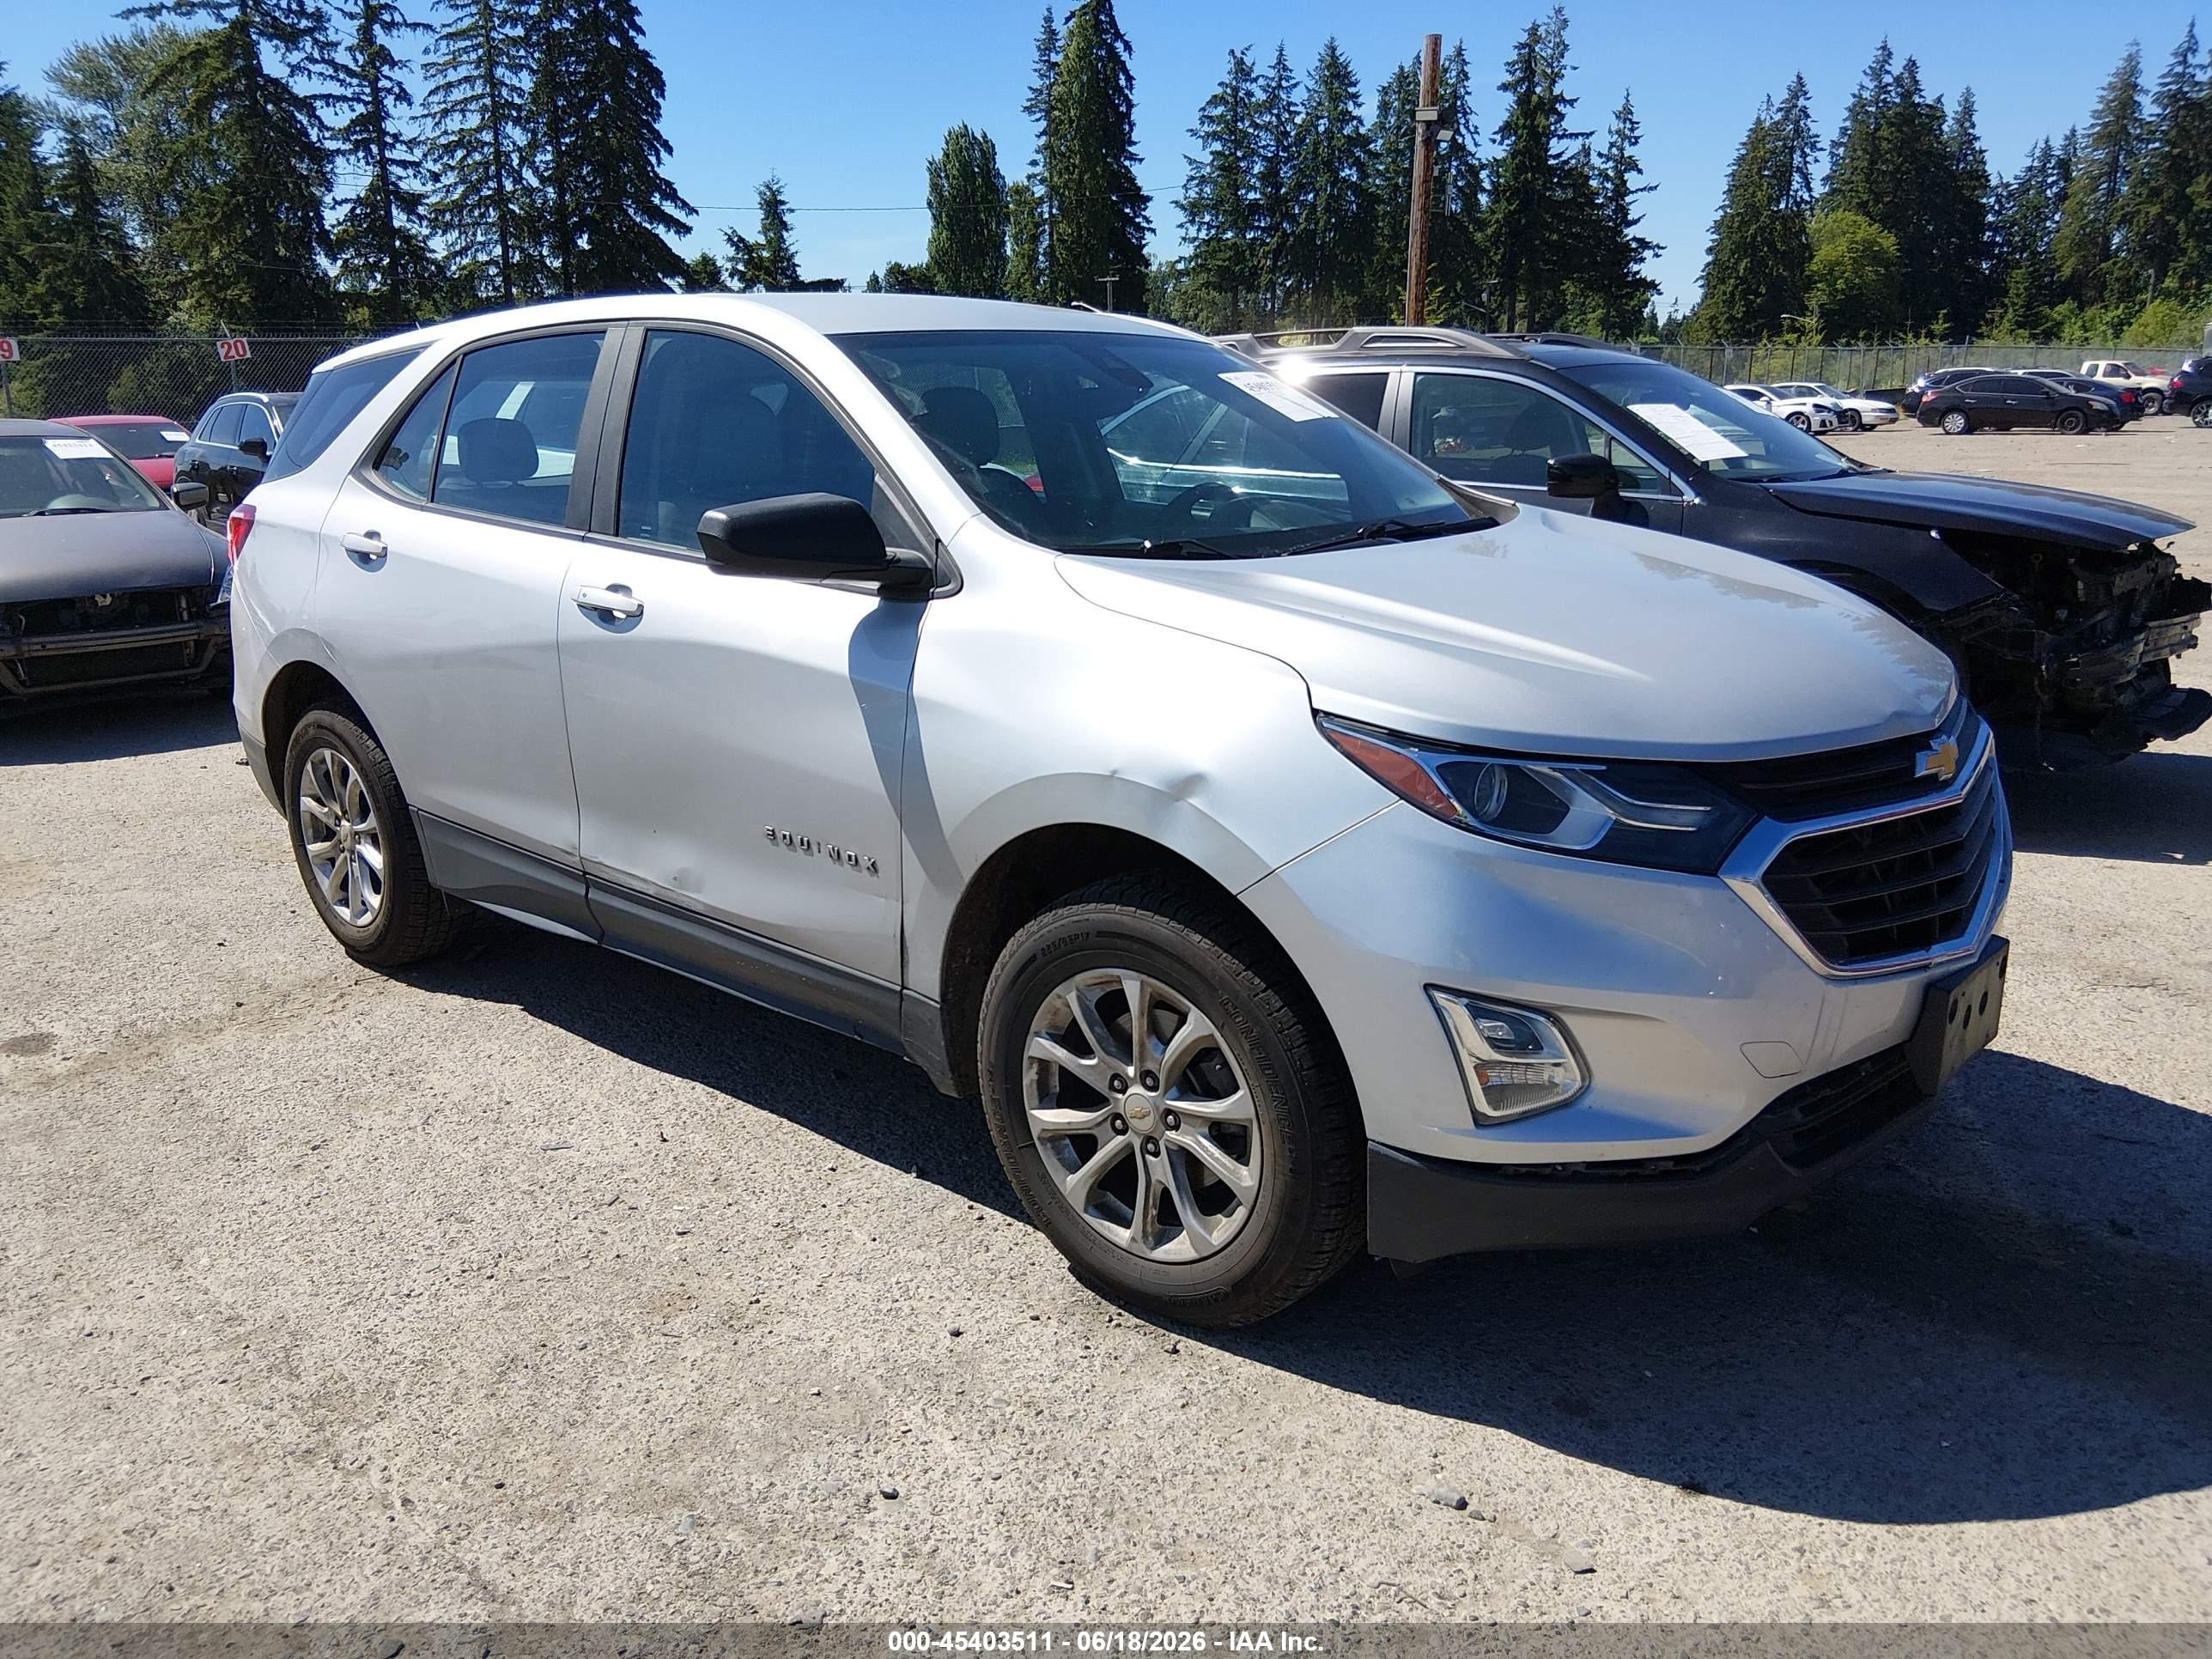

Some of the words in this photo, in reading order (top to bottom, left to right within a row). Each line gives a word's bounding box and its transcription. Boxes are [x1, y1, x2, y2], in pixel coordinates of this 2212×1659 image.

[220, 339, 247, 360] 20
[763, 825, 879, 876] EQUINOX
[1218, 995, 1293, 1145] CONFIDENCE
